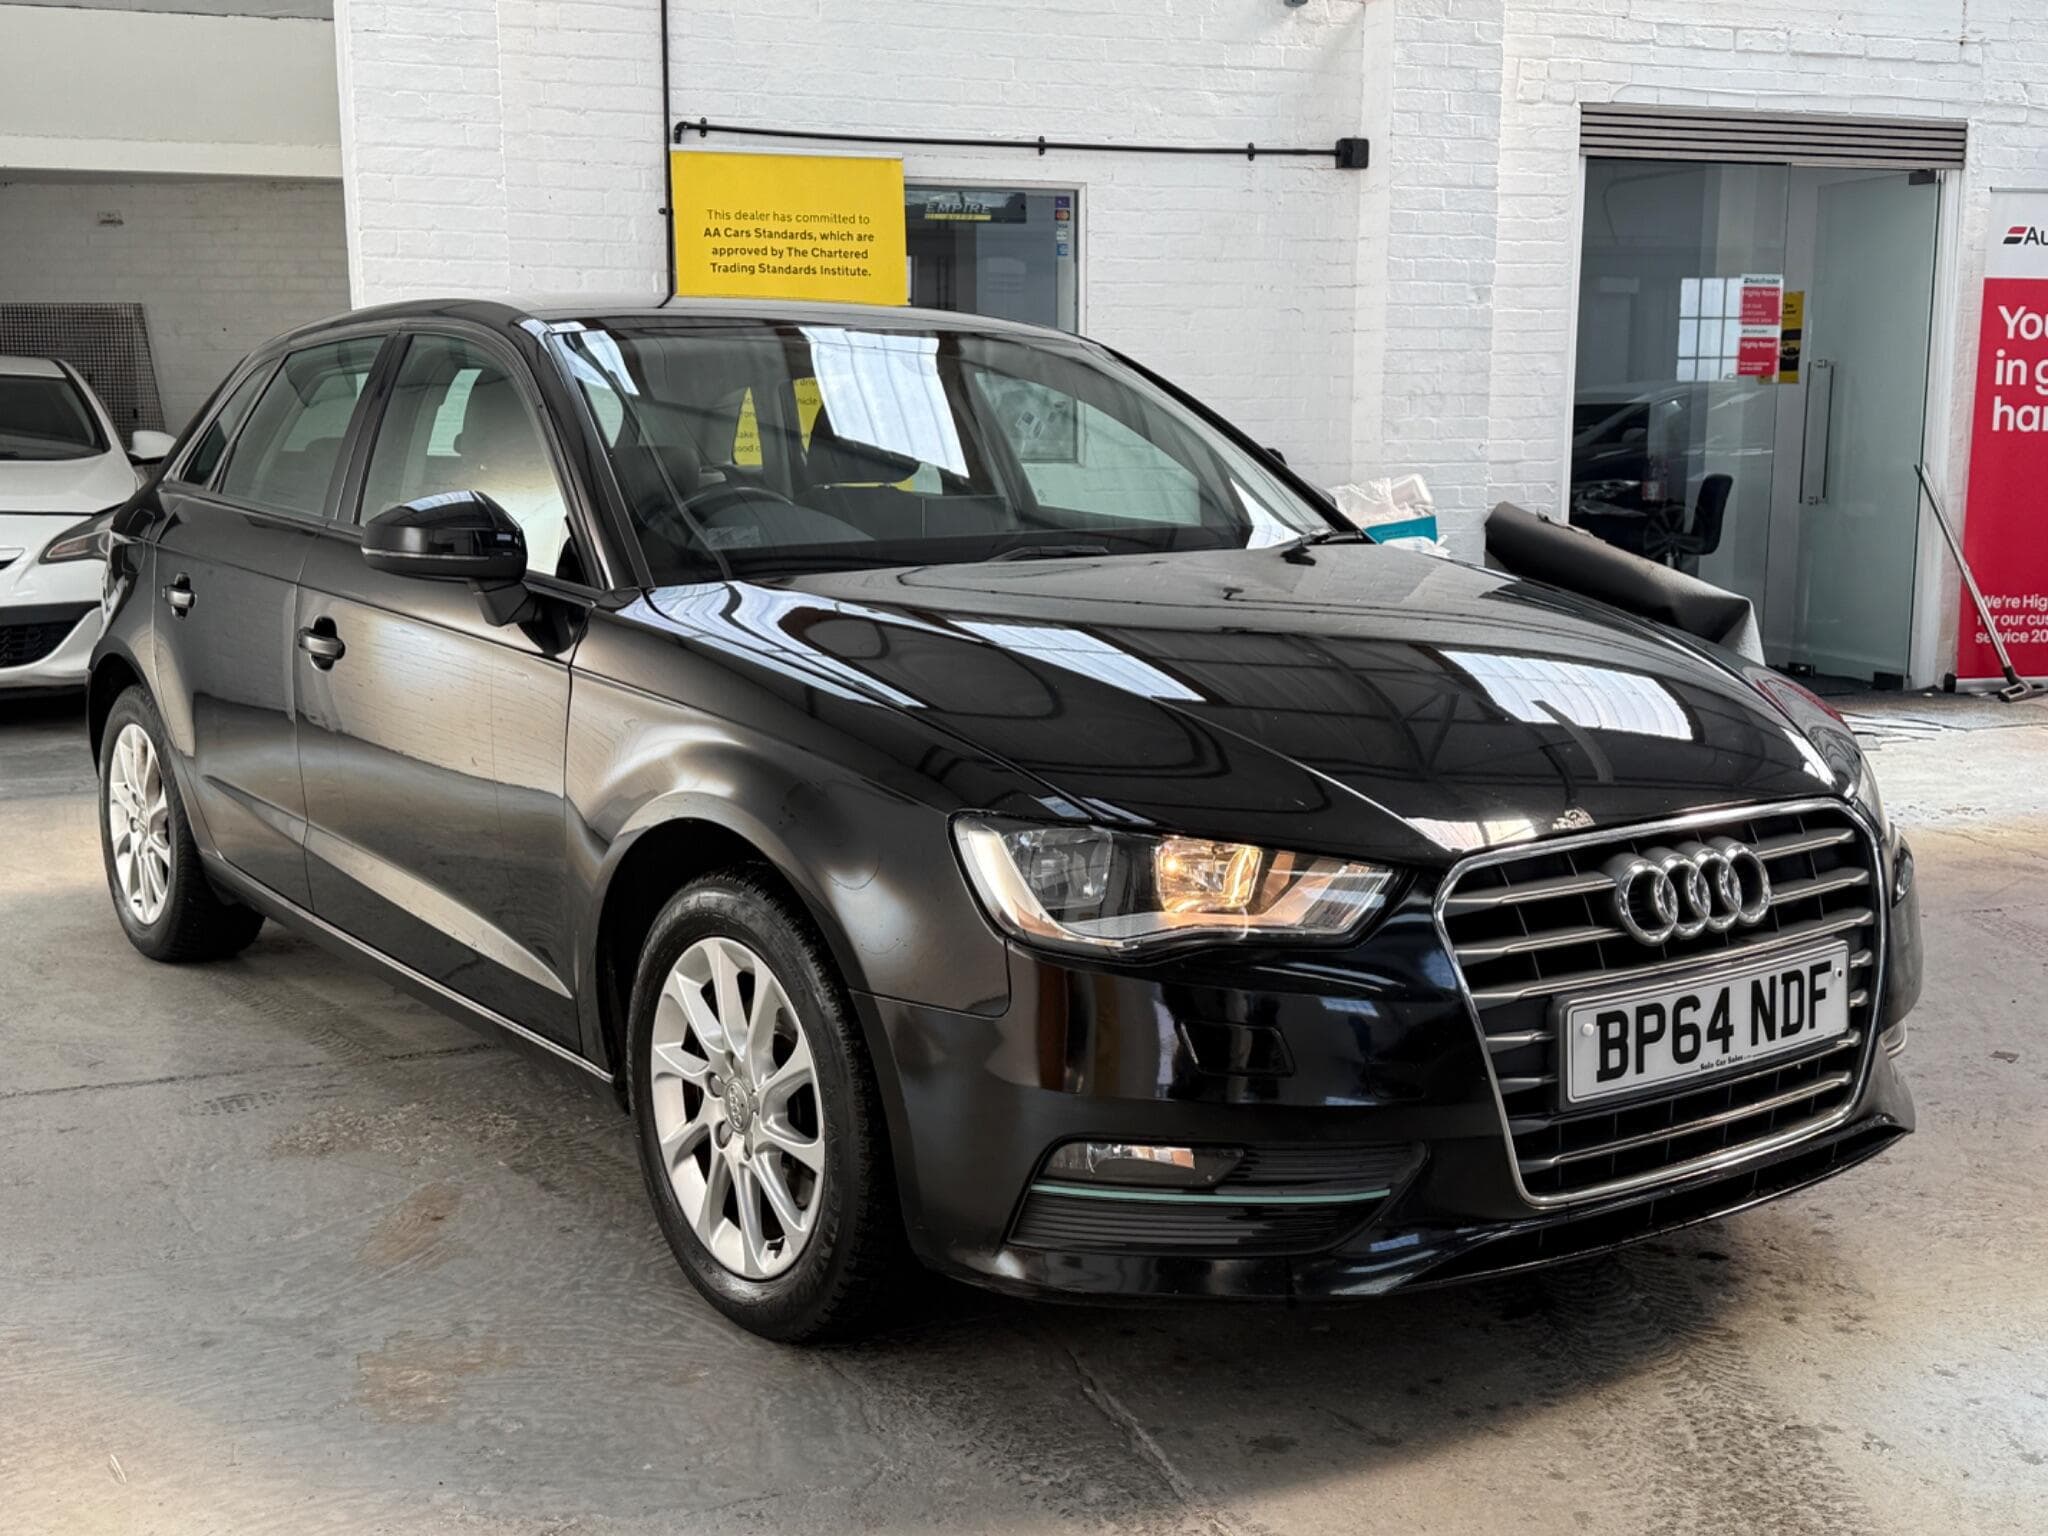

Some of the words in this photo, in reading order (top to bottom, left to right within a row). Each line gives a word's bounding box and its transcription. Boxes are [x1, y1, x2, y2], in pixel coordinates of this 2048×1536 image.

[926, 202, 992, 213] EMPIRE
[706, 208, 731, 221] This
[734, 209, 770, 222] dealer
[772, 211, 793, 223] has
[795, 212, 856, 225] committed
[858, 214, 870, 225] to
[703, 227, 721, 238] AA
[723, 228, 751, 239] Cars
[754, 228, 817, 242] Standards,
[819, 231, 854, 242] which
[856, 233, 875, 243] are
[711, 246, 768, 258] approved
[770, 247, 784, 259] by
[786, 247, 808, 258] The
[811, 248, 869, 260] Chartered
[709, 262, 756, 275] Trading
[758, 263, 817, 275] Standards
[820, 264, 872, 277] Institute.
[1998, 305, 2048, 340] Yo
[1995, 348, 2028, 386] in
[2000, 614, 2026, 626] our
[1975, 629, 2030, 644] sevice
[1596, 986, 1734, 1083] BP64
[1750, 960, 1833, 1047] NDF
